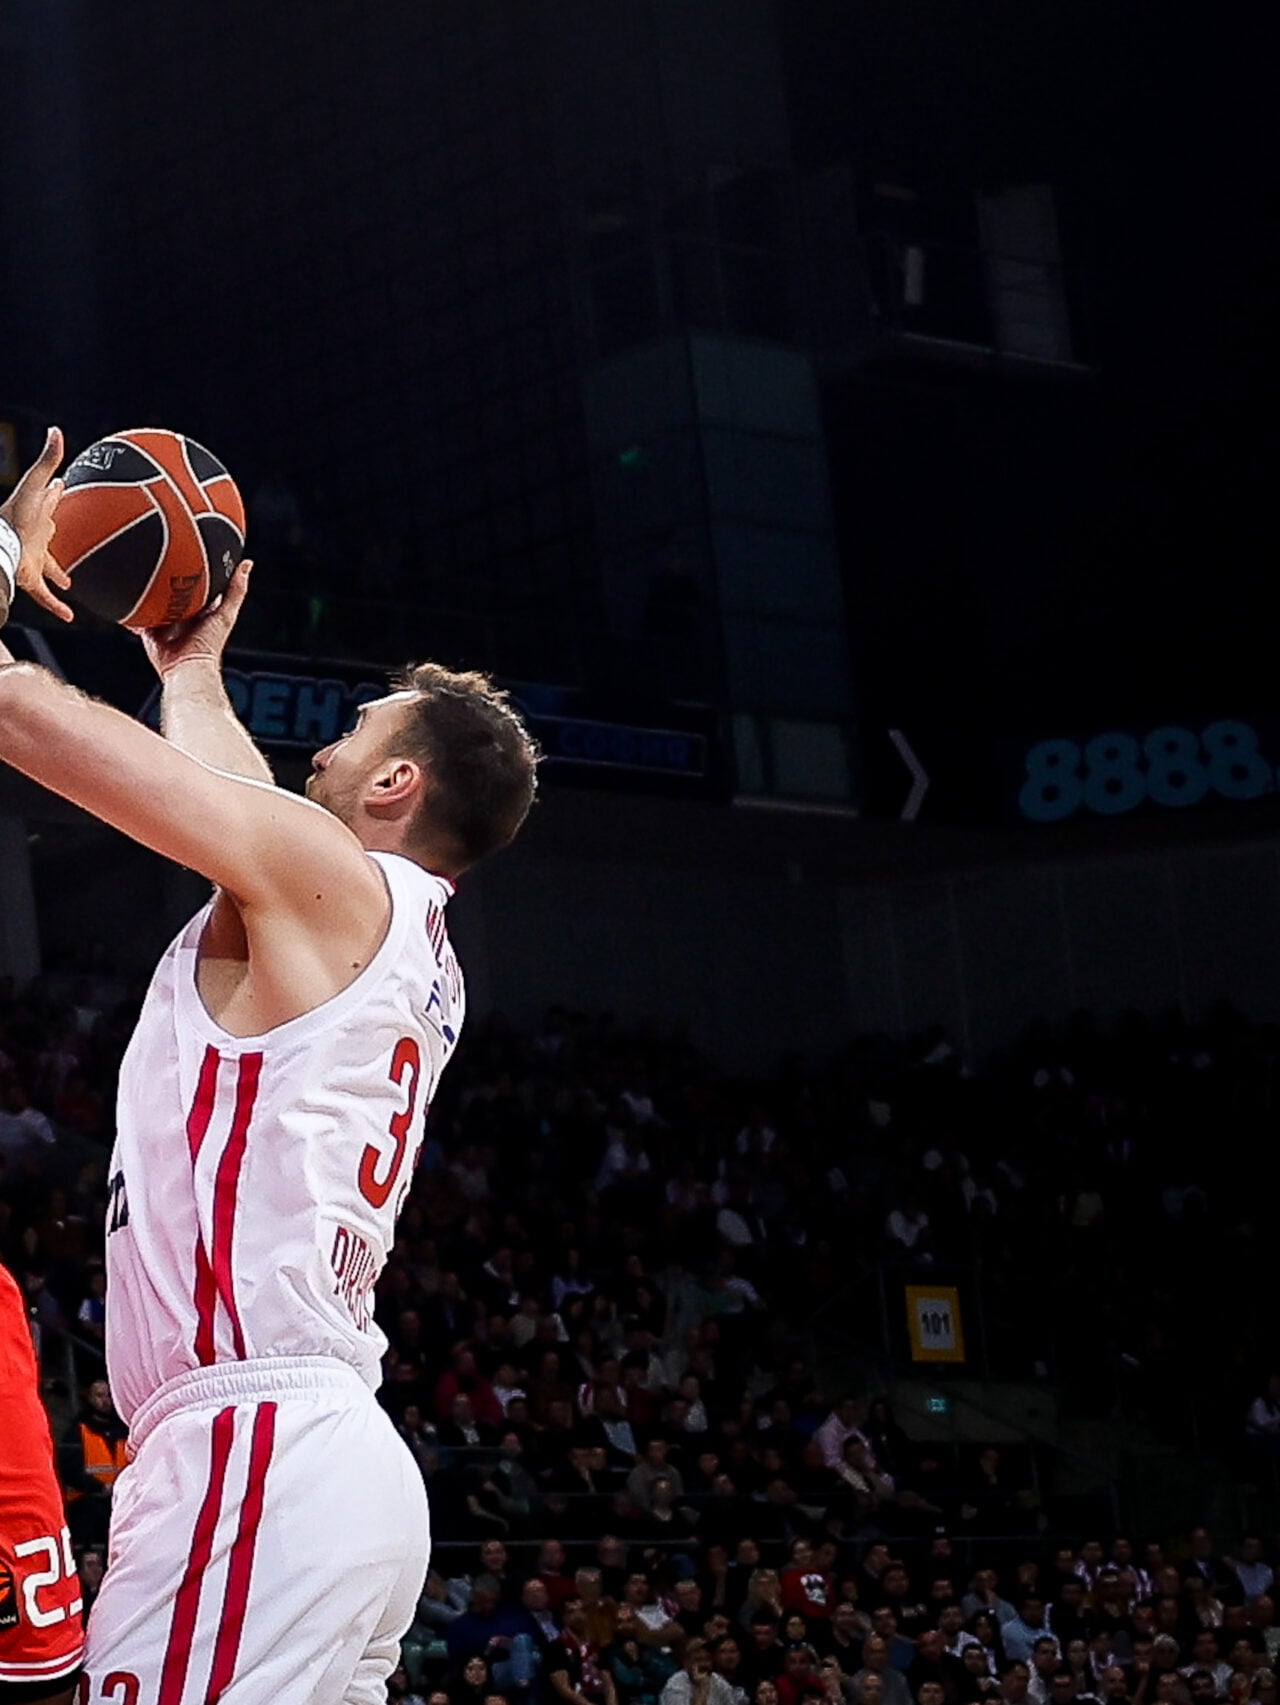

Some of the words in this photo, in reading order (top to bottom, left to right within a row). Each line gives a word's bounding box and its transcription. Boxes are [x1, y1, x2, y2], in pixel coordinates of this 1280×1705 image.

[1019, 718, 1272, 823] 8888
[357, 1036, 426, 1212] 3
[921, 1310, 950, 1335] 101
